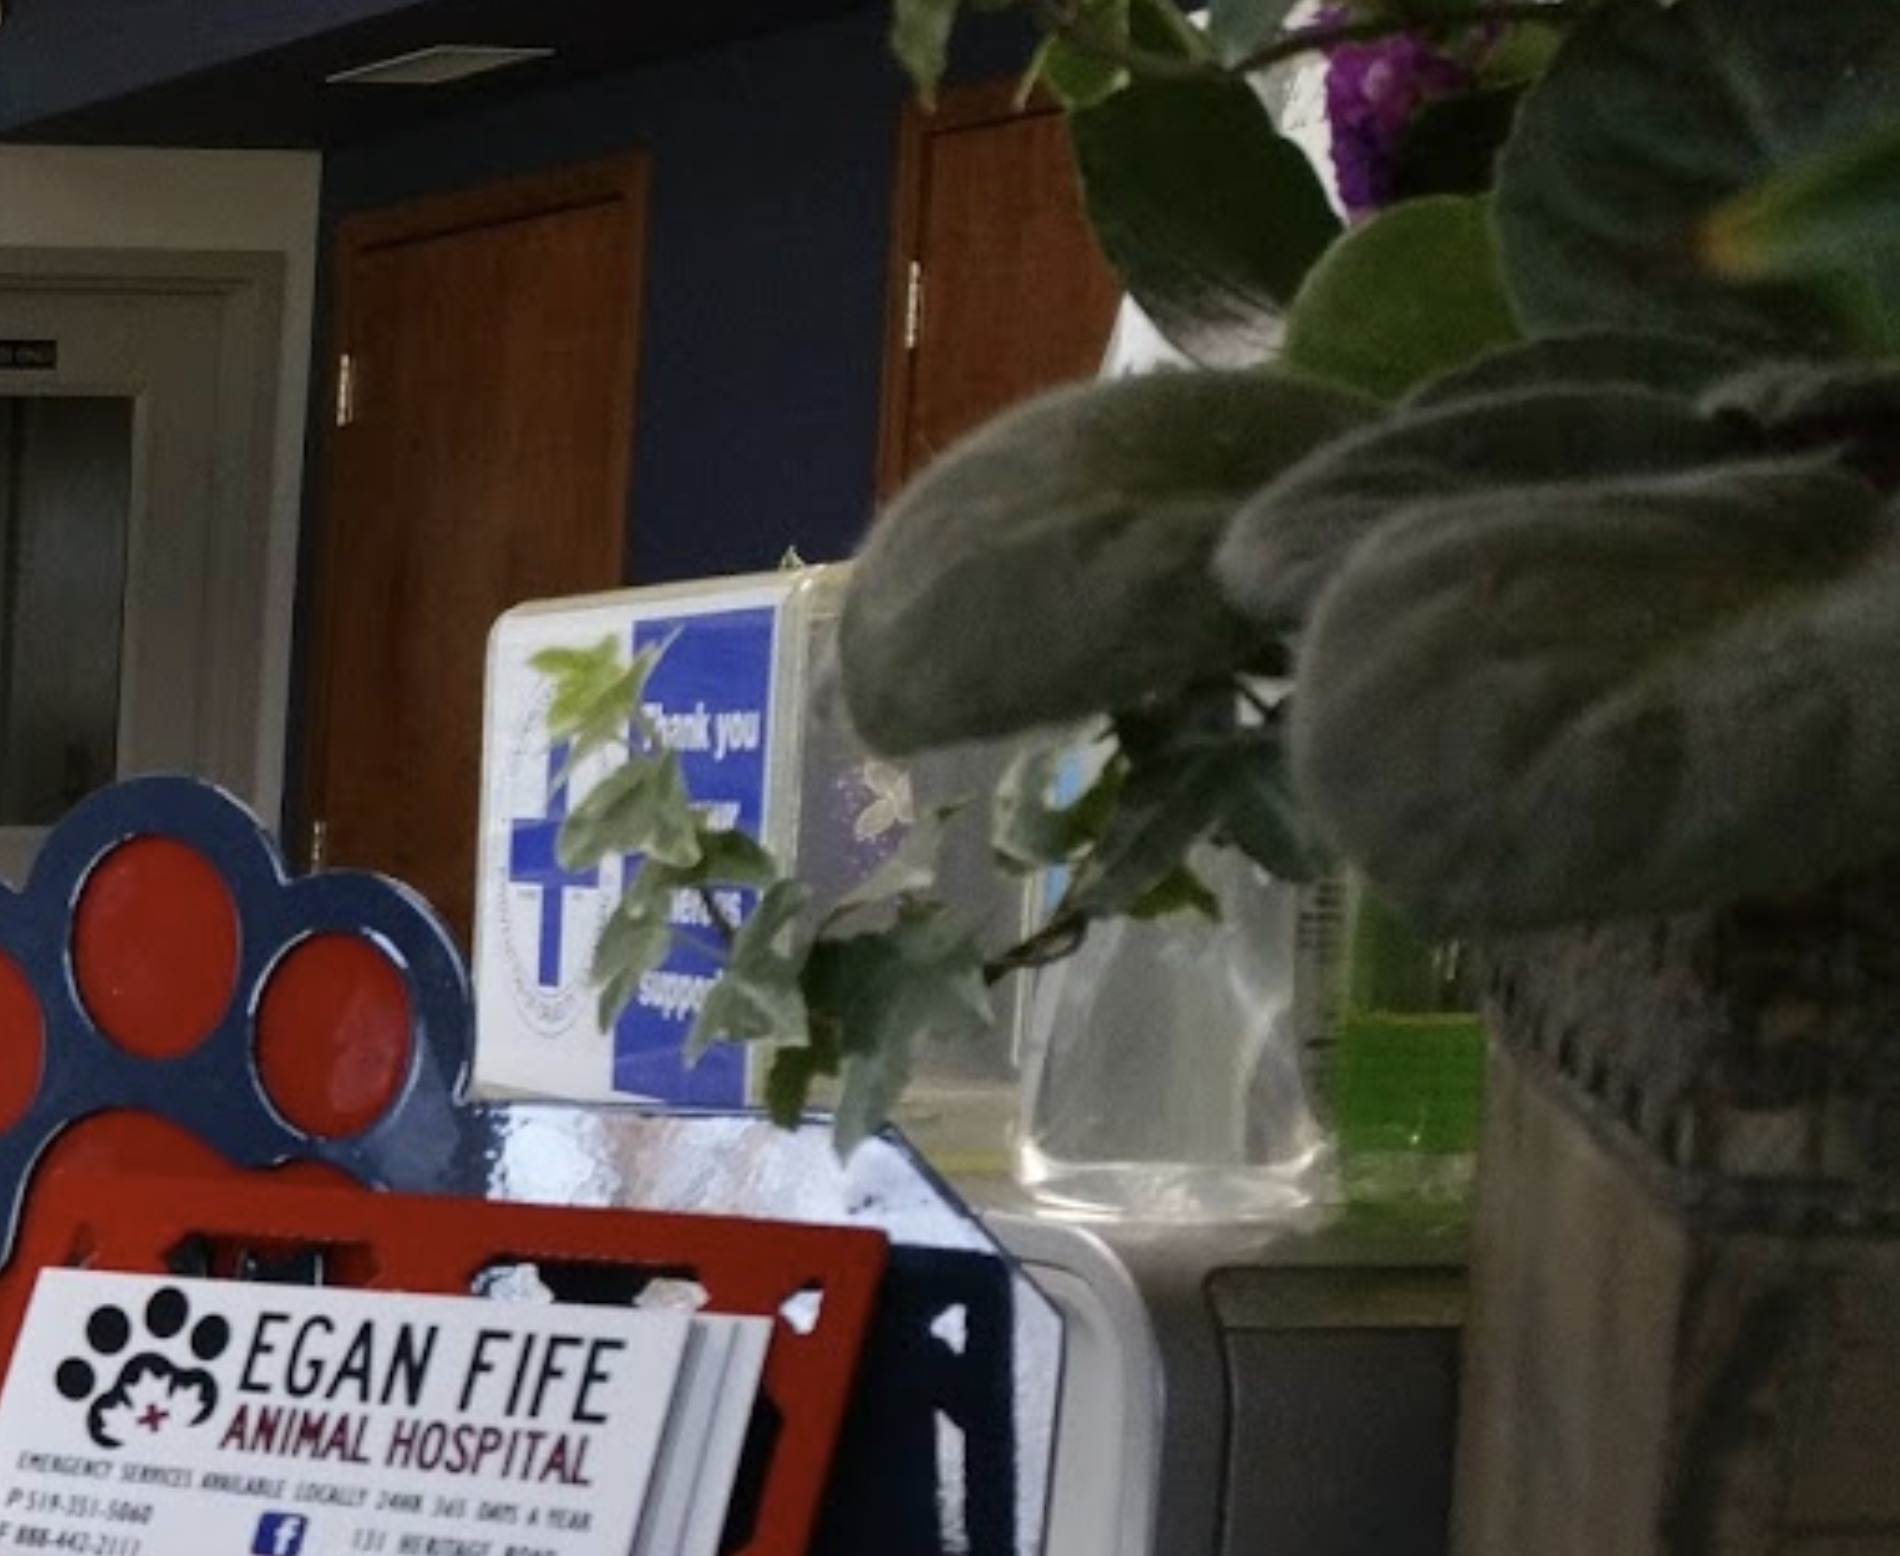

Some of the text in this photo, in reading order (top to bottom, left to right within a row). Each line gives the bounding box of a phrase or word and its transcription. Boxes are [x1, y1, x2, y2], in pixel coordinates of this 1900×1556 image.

[714, 709, 762, 763] you
[237, 1310, 628, 1425] EGAN FIFE
[218, 1402, 592, 1488] ANIMAL HOSPITAL
[16, 1450, 113, 1477] EMERGENCY
[119, 1463, 194, 1489] SERVICES
[200, 1471, 286, 1500] AVAILABLE
[293, 1479, 368, 1508] LOCALLY
[476, 1501, 519, 1526] DAYS
[525, 1505, 540, 1527] A
[546, 1508, 594, 1533] YEAR
